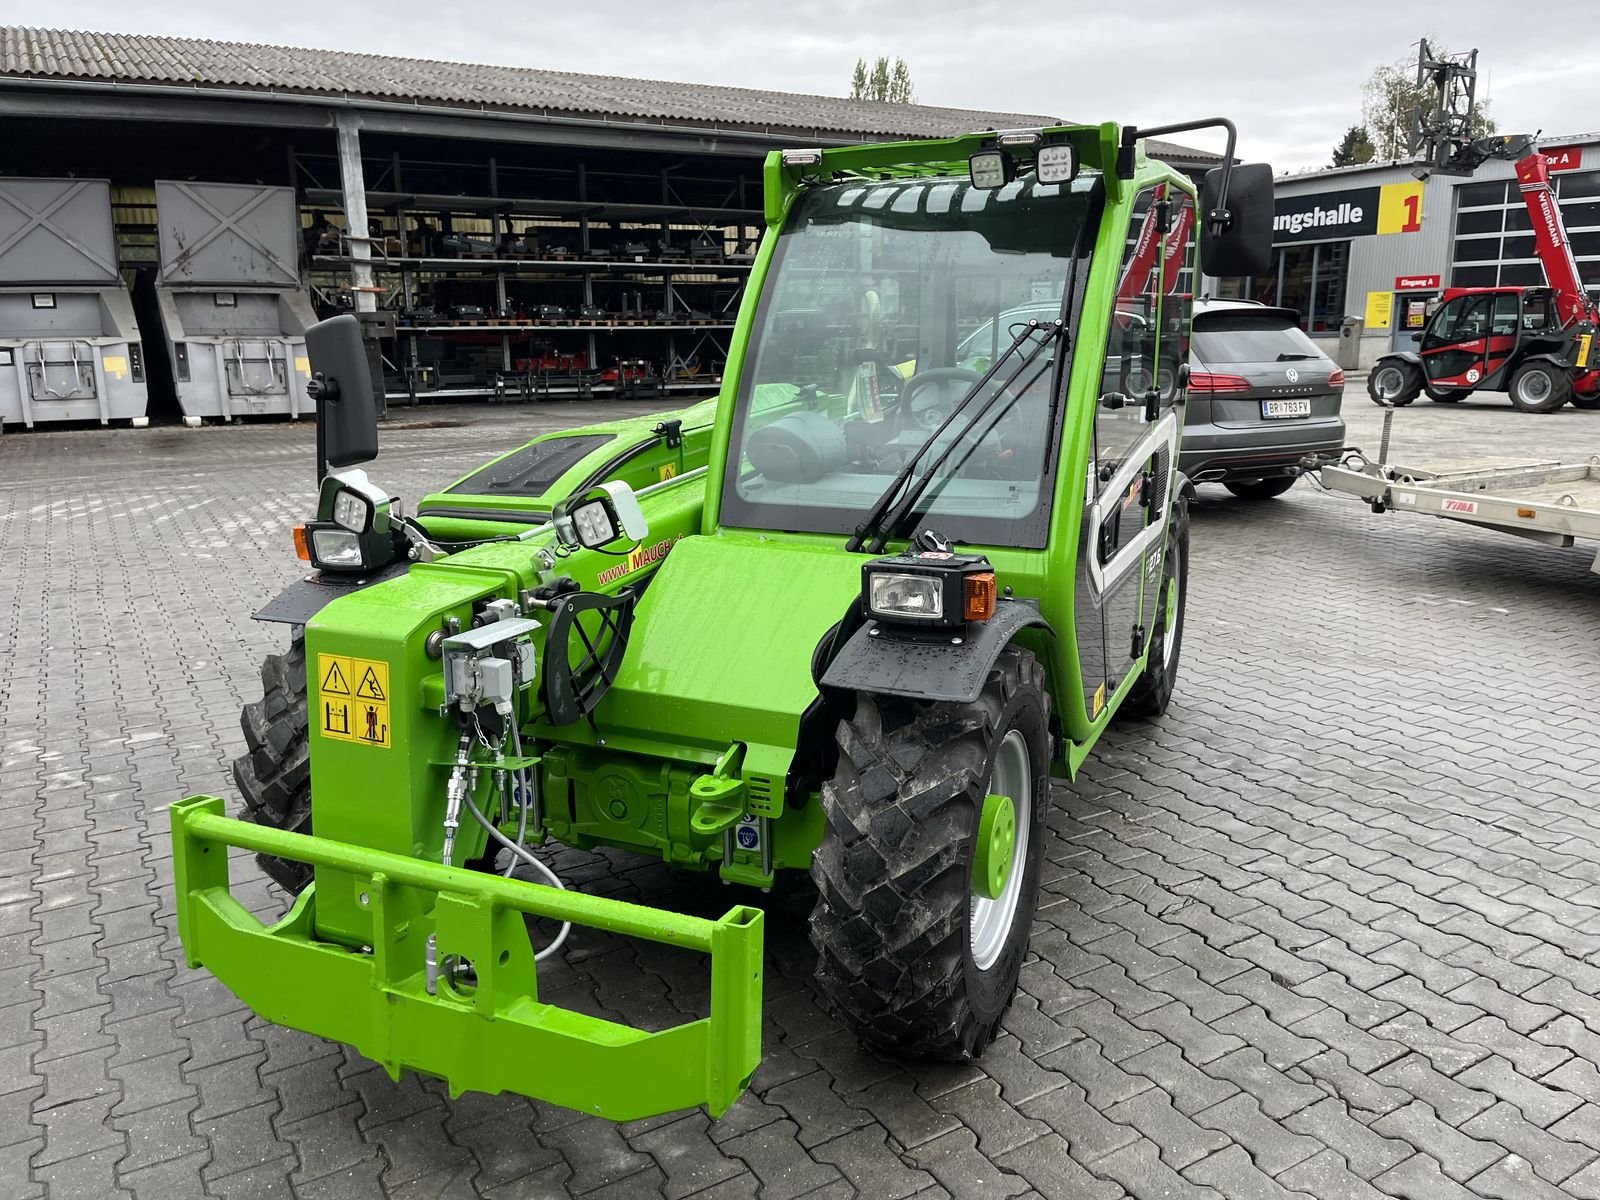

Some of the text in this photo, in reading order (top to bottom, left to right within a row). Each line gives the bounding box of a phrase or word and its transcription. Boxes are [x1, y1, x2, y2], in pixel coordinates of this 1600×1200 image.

[1560, 153, 1569, 164] A
[1401, 195, 1421, 233] 1
[1538, 192, 1560, 248] WEIDEMANN
[1401, 279, 1427, 288] Eingang
[1468, 371, 1477, 381] 35
[1269, 402, 1279, 414] BR
[1446, 501, 1473, 512] TIMA
[598, 533, 684, 586] www.MAUCH
